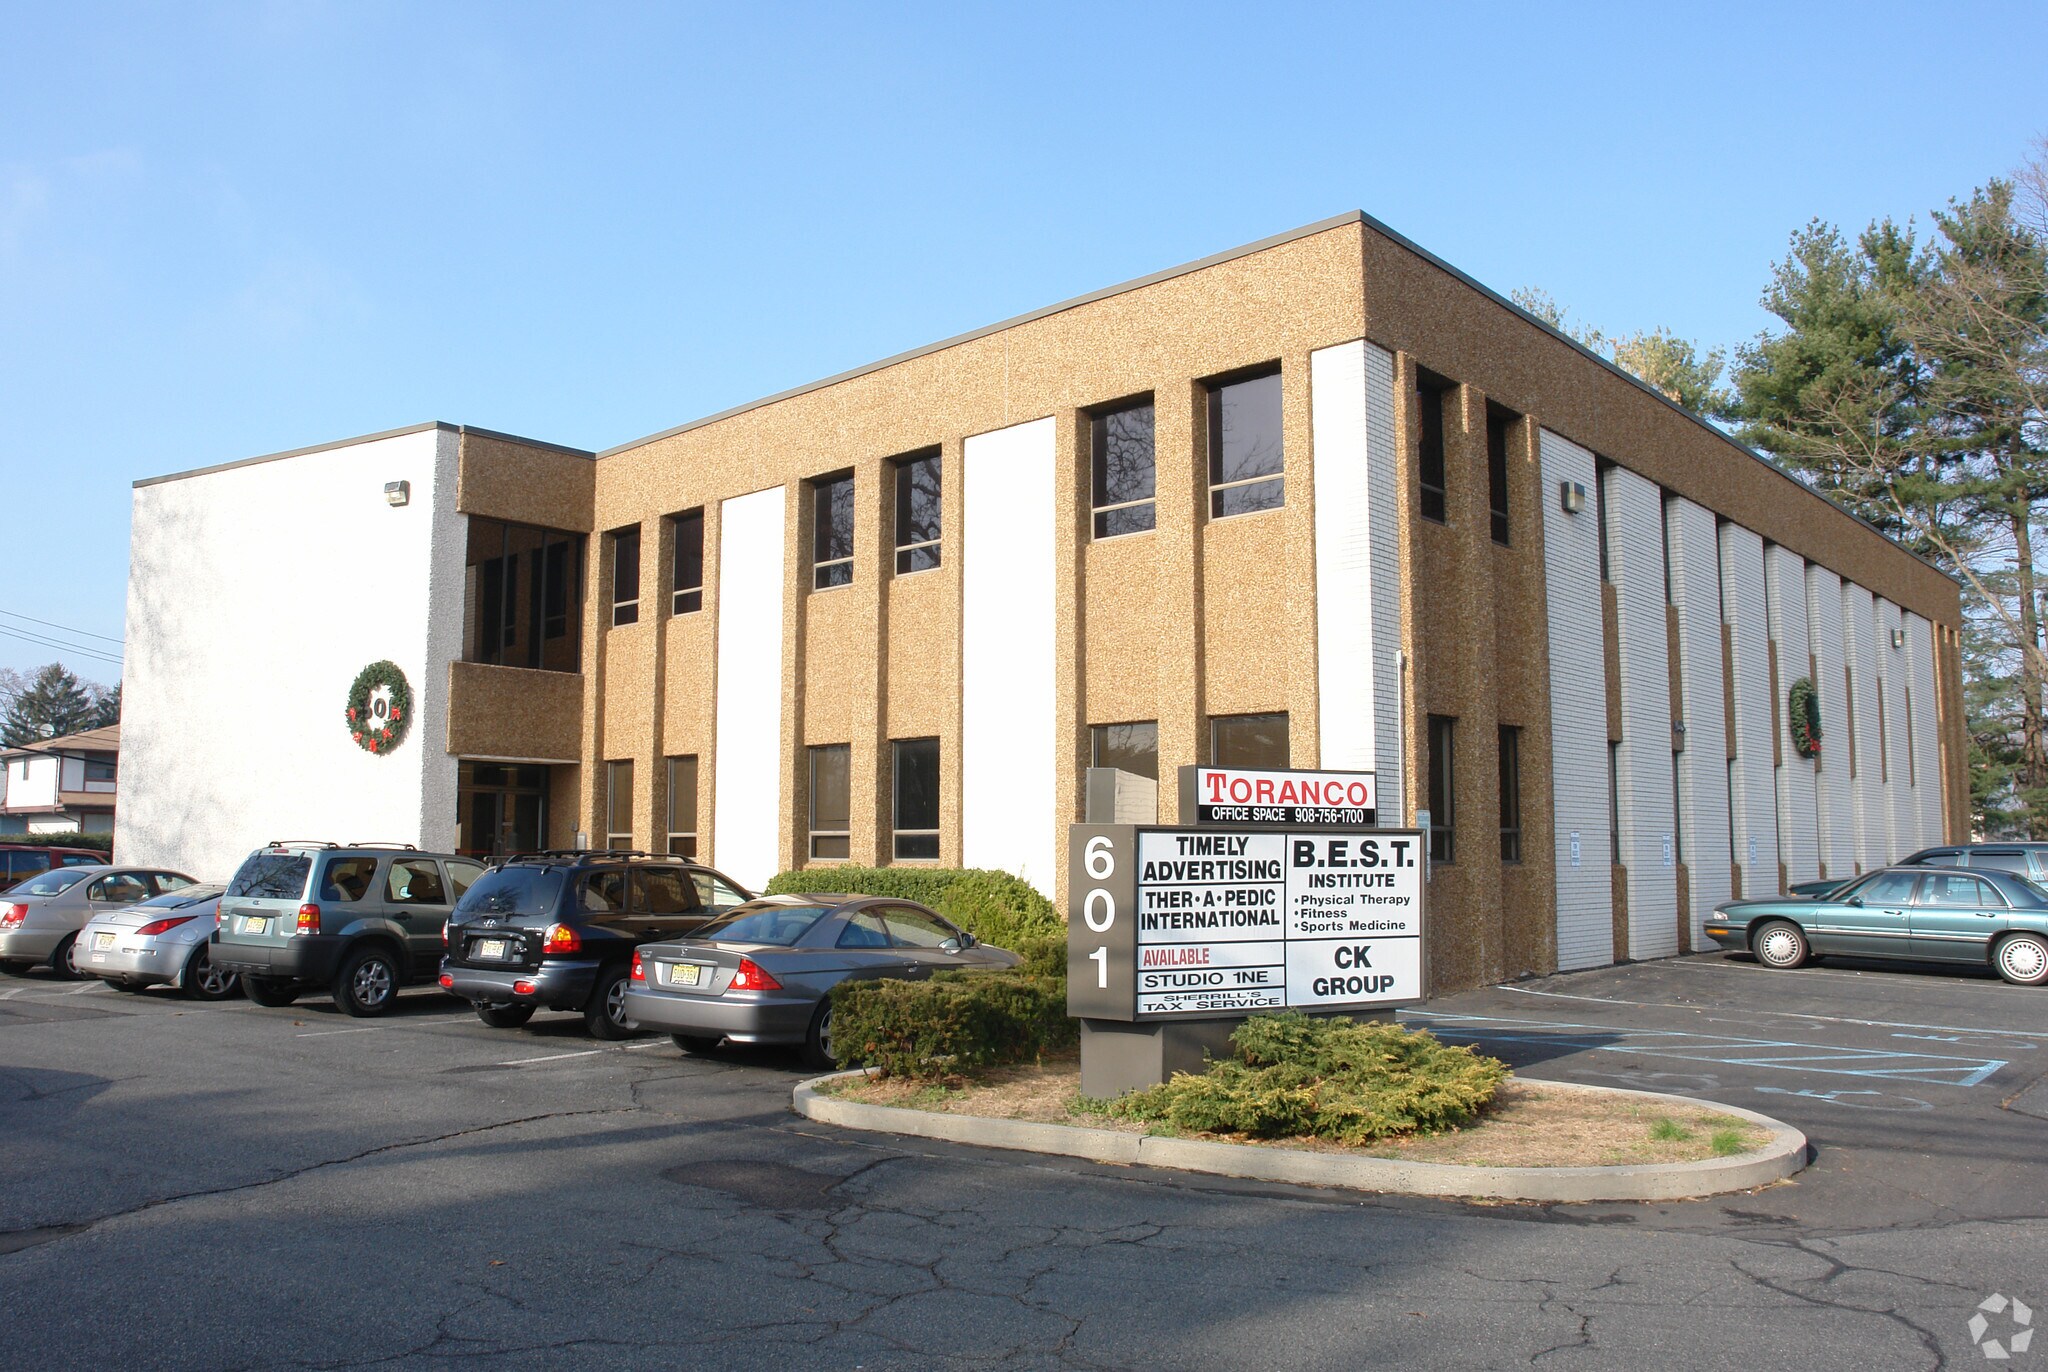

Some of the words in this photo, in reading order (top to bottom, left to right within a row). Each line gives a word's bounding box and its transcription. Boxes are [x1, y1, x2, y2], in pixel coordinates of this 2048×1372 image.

[1206, 773, 1368, 807] TORANCO
[1211, 806, 1250, 821] OFFICE
[1252, 807, 1286, 822] SPACE
[1295, 808, 1364, 824] 908-756-1700
[1176, 836, 1249, 856] TIMELY
[1293, 840, 1414, 868] B.E.S.T.
[1143, 860, 1281, 881] ADVERTISING
[1308, 874, 1395, 888] INSTITUTE
[1301, 894, 1354, 907] Physical
[1360, 894, 1410, 906] Therapy
[1141, 909, 1280, 930] INTERNATIONAL
[1300, 908, 1347, 919] Fitness
[1300, 921, 1343, 933] Sports
[1349, 920, 1406, 931] Medicine
[1143, 948, 1210, 966] AVAILABLE
[1334, 946, 1372, 969] CK
[1144, 972, 1224, 988] STUDIO
[1233, 971, 1269, 984] 1NE
[1313, 975, 1394, 996] GROUP
[1143, 1002, 1183, 1012] TAX
[1196, 997, 1280, 1010] SERVICE
[1163, 991, 1262, 1002] SHERRILL'S
